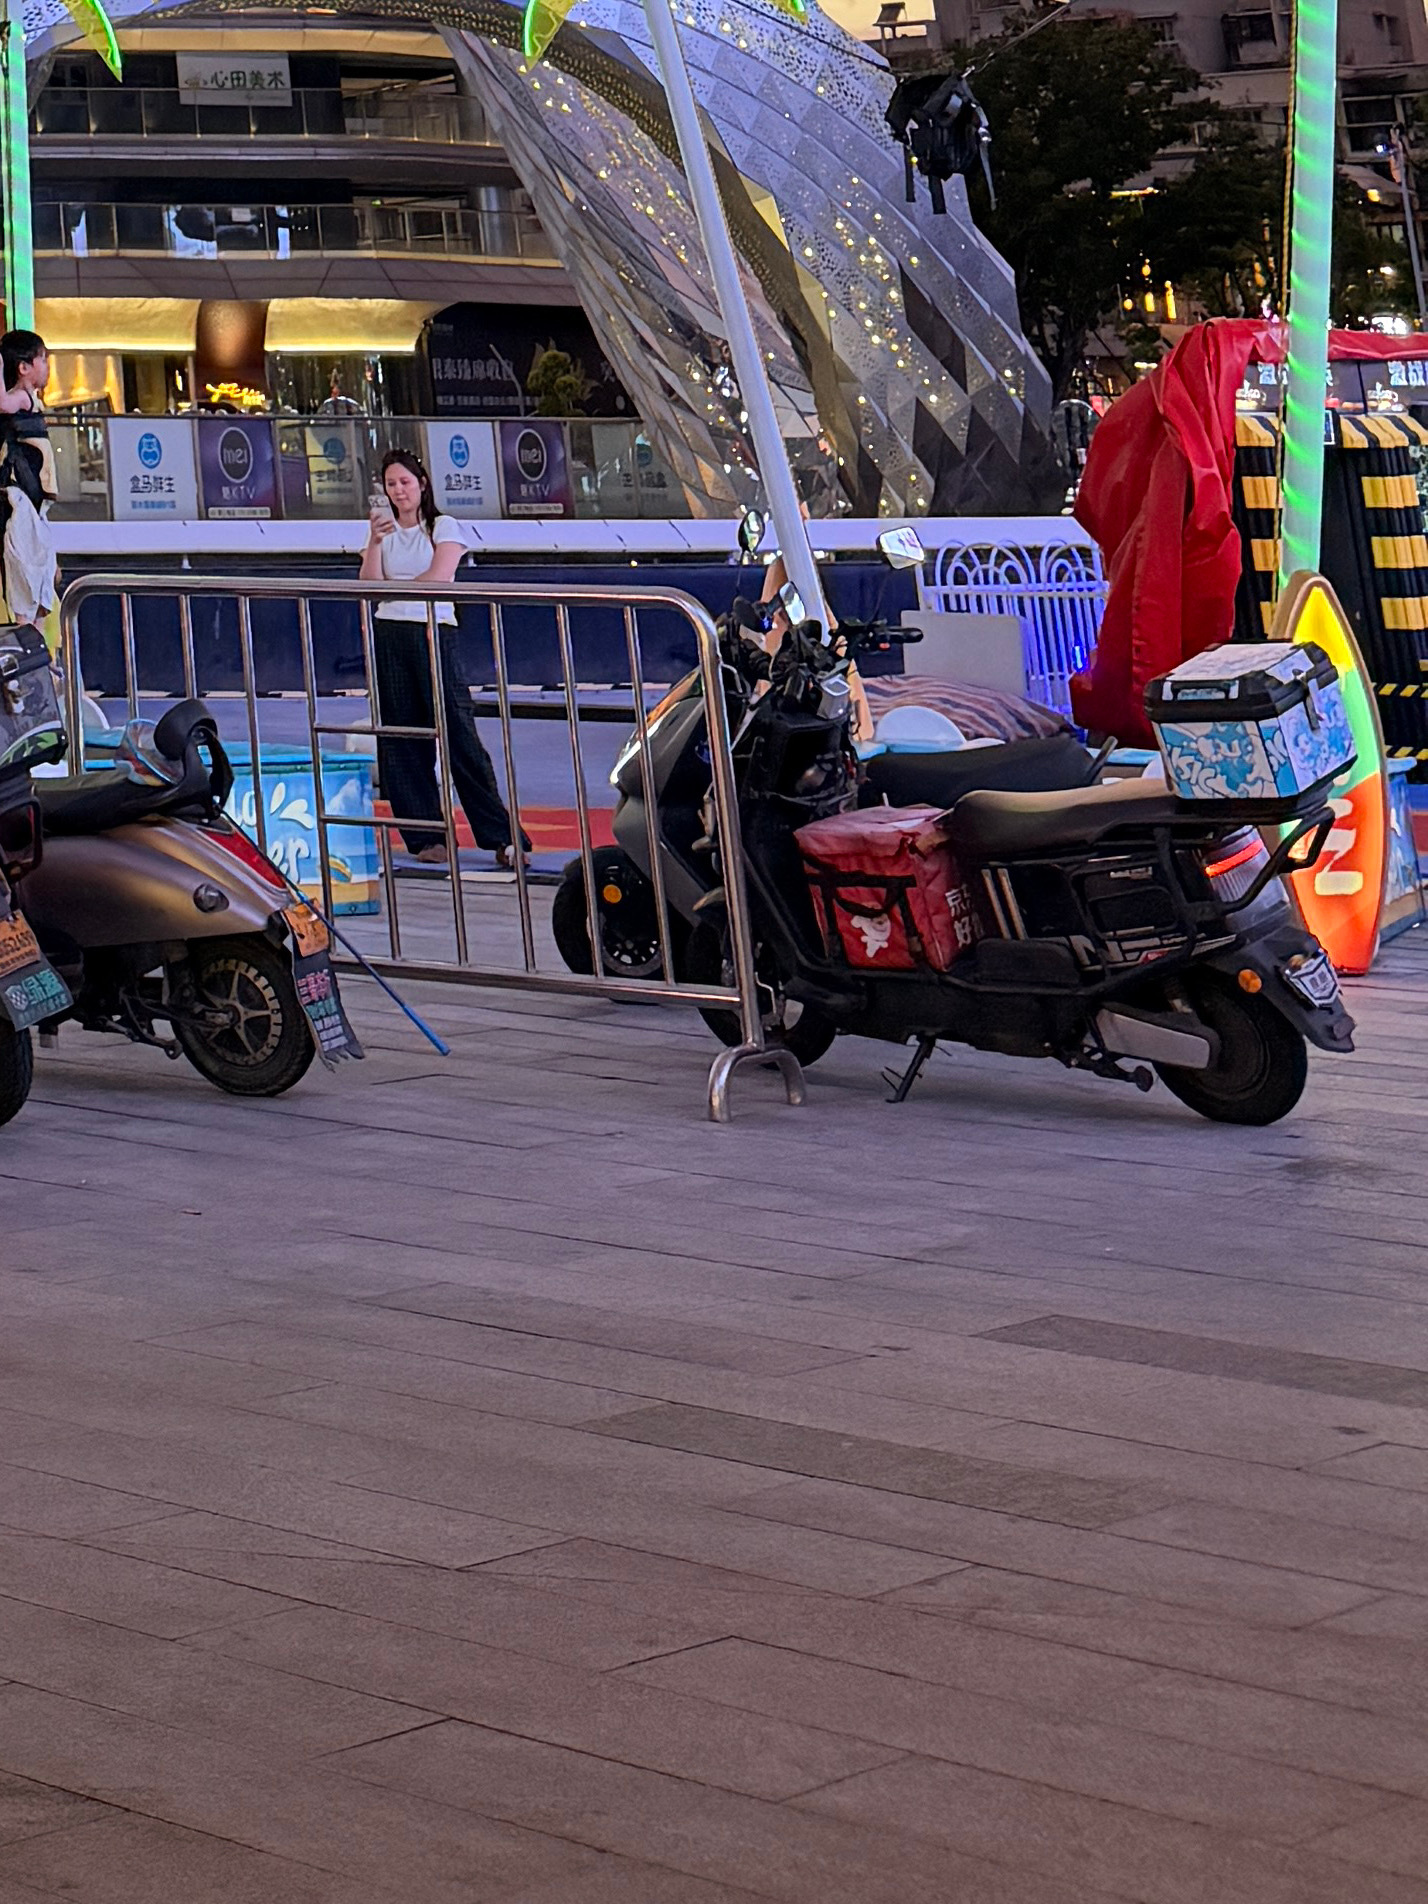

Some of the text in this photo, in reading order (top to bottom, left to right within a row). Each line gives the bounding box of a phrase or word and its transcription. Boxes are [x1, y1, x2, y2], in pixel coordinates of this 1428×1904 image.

[223, 447, 248, 464] mei
[520, 447, 543, 464] mei
[130, 475, 176, 494] 盒马鲜生
[444, 473, 483, 491] 盒马鲜生
